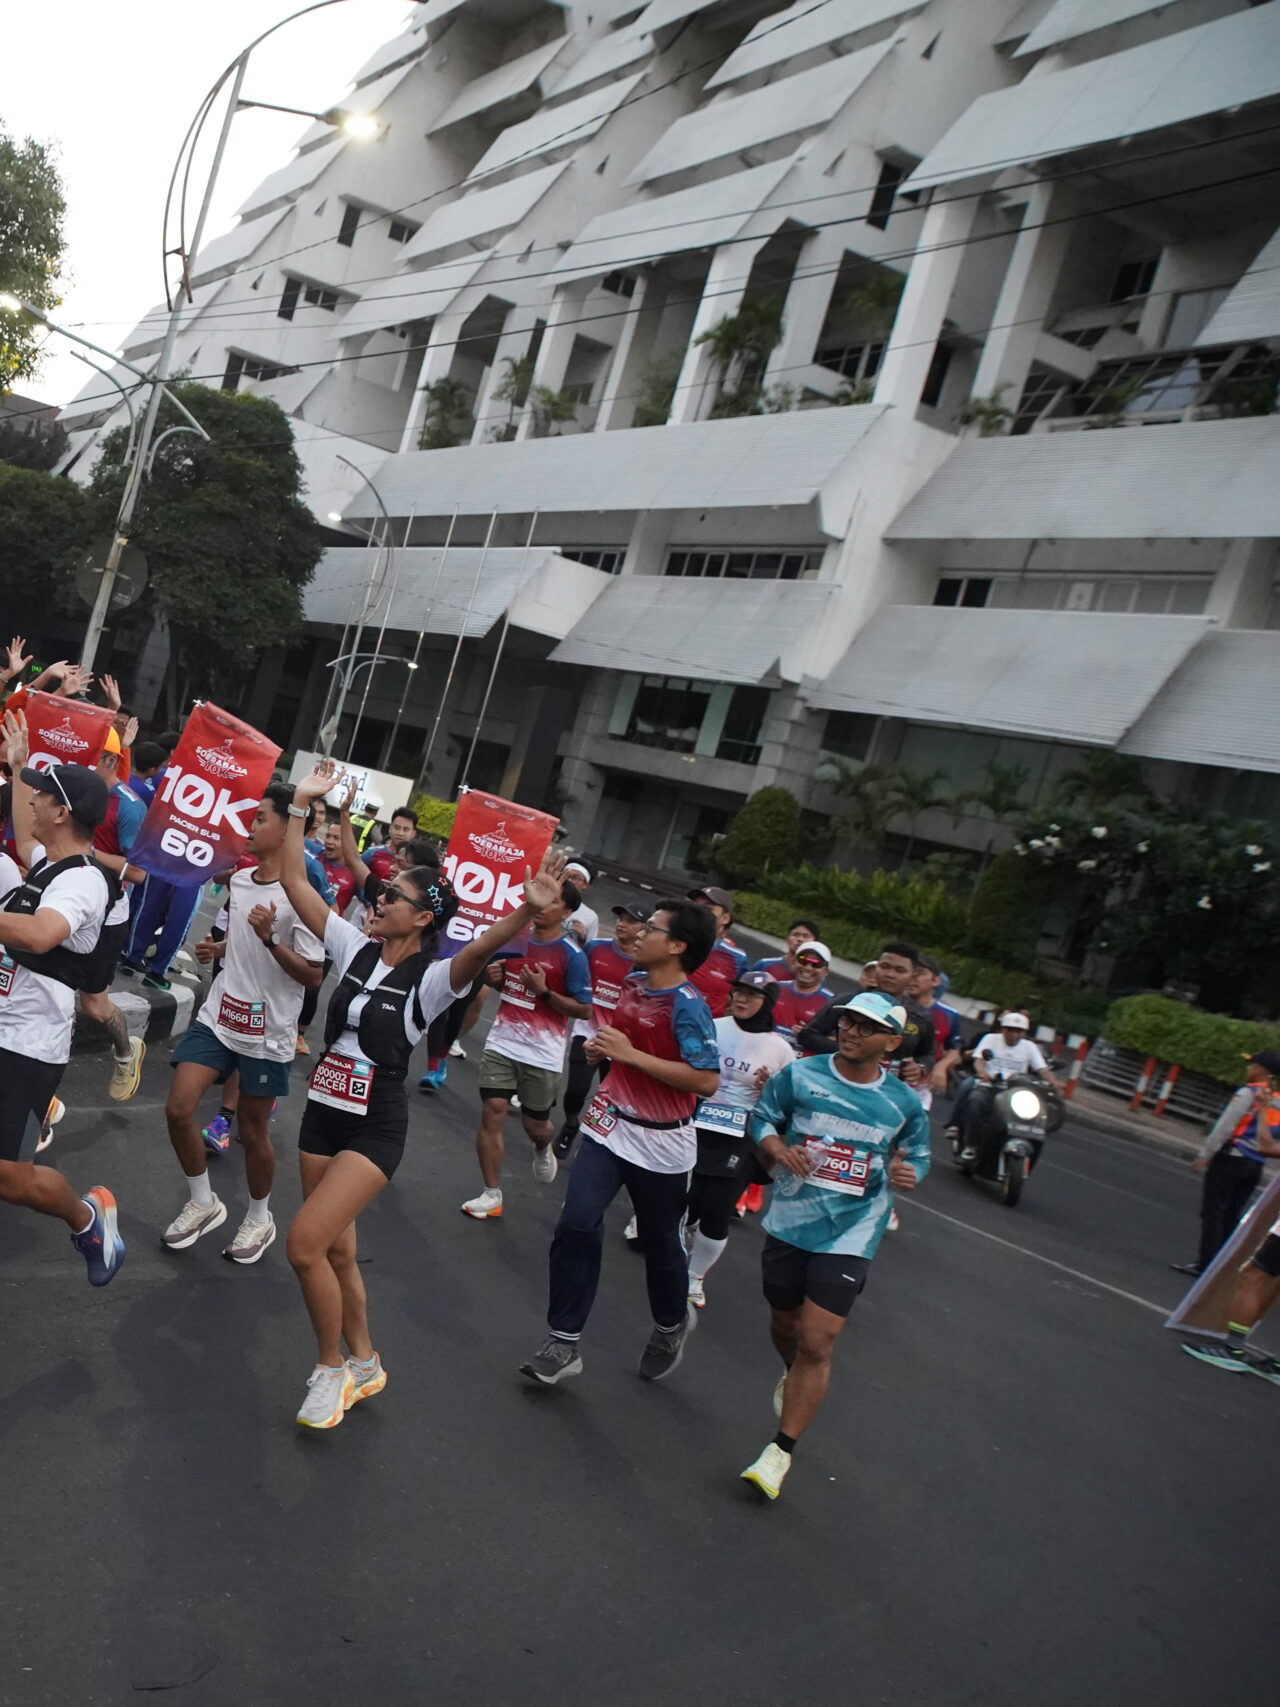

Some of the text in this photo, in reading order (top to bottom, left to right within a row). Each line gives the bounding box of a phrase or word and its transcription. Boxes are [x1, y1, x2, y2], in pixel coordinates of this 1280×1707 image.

[38, 728, 89, 748] SOERABAJA
[195, 746, 248, 776] SOERABAJA
[161, 764, 261, 838] 10K
[169, 814, 220, 841] PACER SUB
[160, 828, 214, 867] 60
[468, 833, 525, 858] SOERABAJA
[457, 905, 504, 922] ACER SU
[221, 1005, 248, 1024] M1668
[314, 1074, 347, 1093] PACER
[700, 1106, 732, 1120] F3009
[823, 1156, 849, 1171] 760
